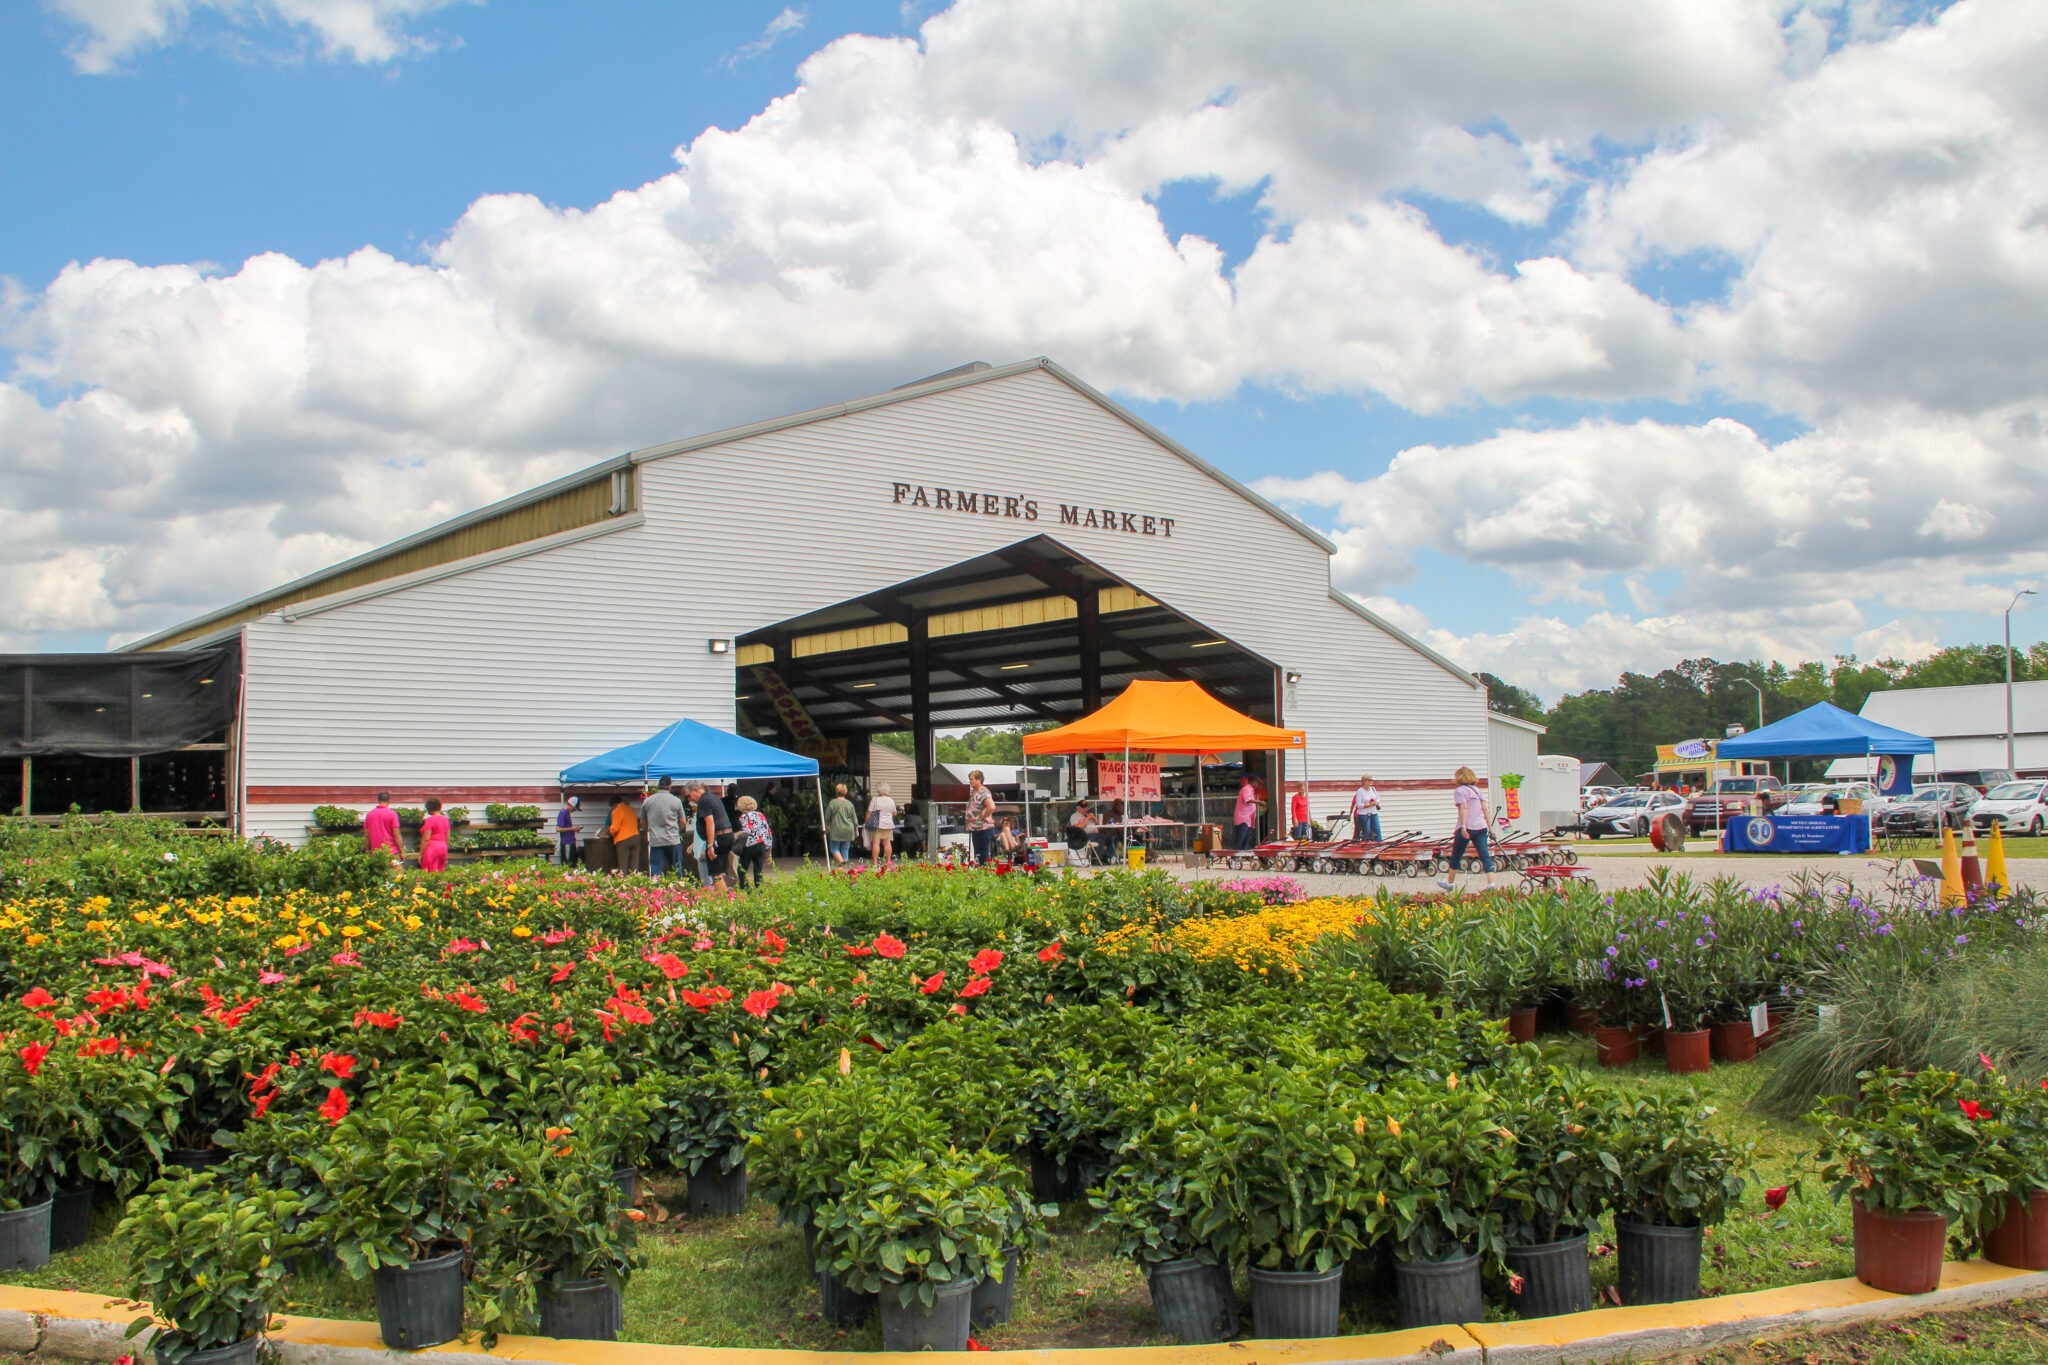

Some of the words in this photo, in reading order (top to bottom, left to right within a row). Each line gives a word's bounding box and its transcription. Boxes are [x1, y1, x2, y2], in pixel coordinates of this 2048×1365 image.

[892, 482, 1038, 521] FARMER'S
[1060, 504, 1175, 536] MARKET
[1100, 763, 1139, 774] WAGONS
[1140, 764, 1158, 774] FOR
